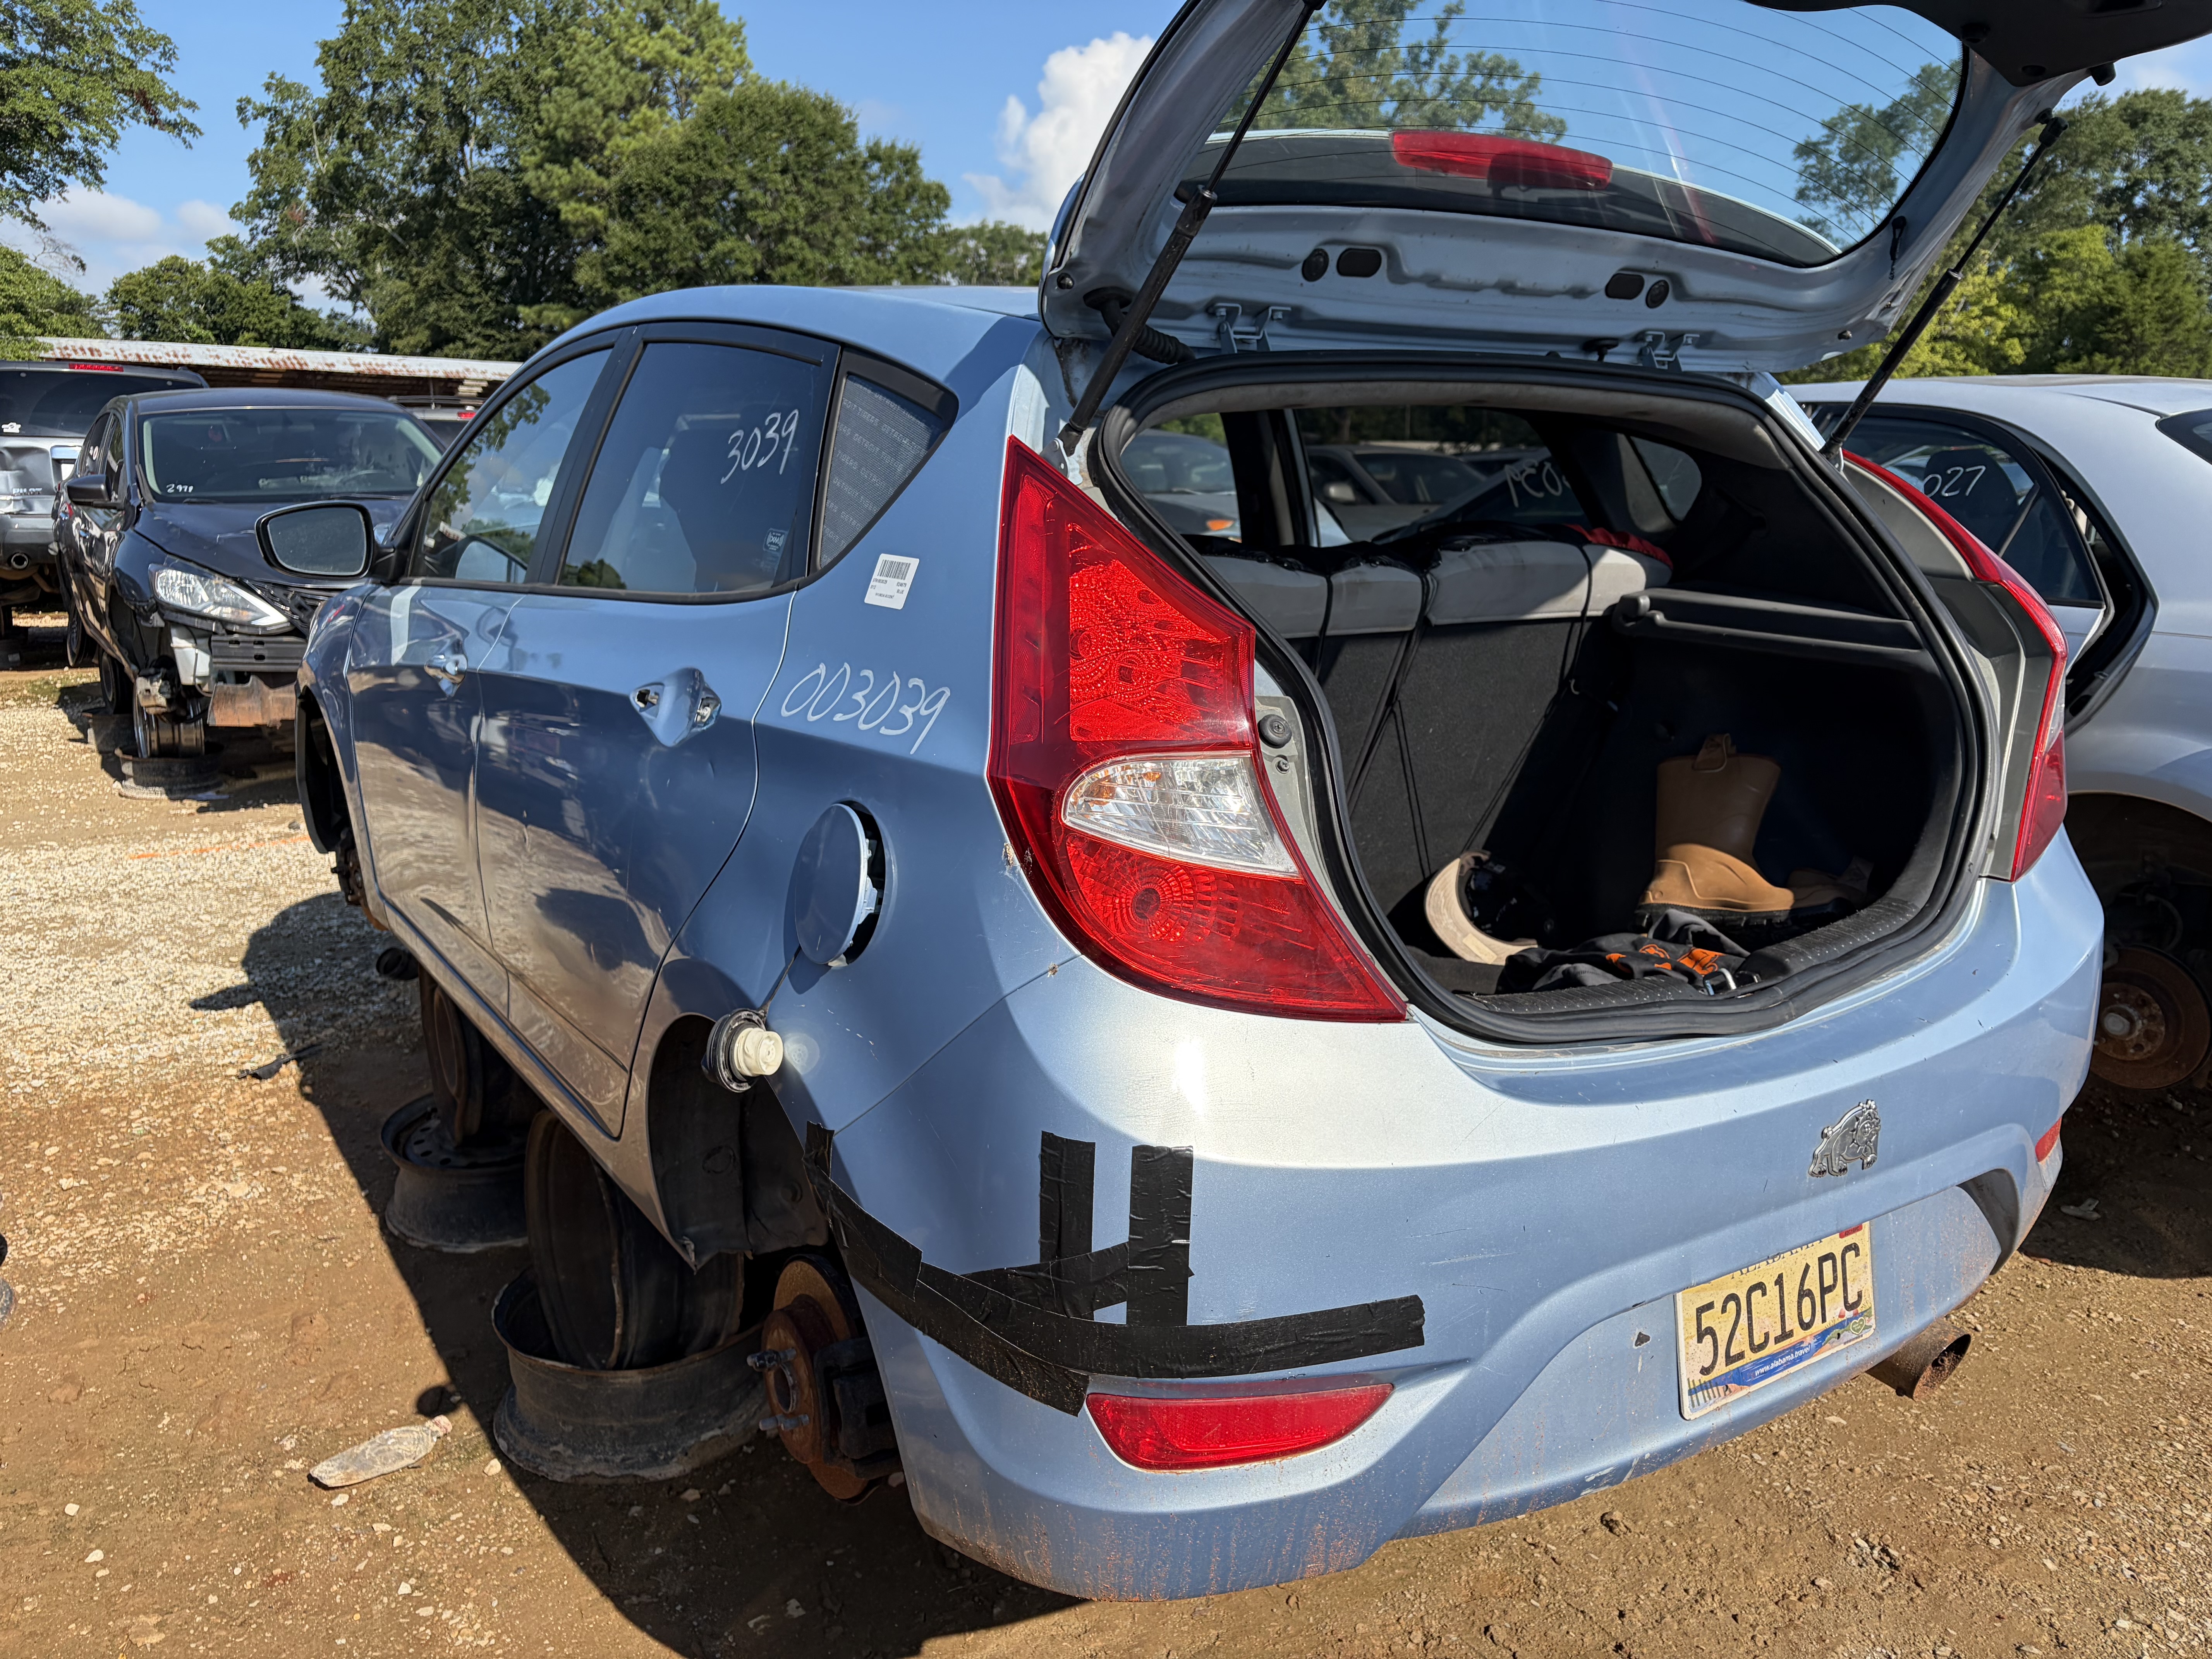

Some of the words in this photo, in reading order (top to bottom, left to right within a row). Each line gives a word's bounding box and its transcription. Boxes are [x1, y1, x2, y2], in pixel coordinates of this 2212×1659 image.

[721, 409, 799, 484] 3039
[781, 662, 951, 754] 003039
[1696, 1242, 1862, 1376] 52C16PC
[1754, 1345, 1811, 1377] www.alabama.travel
